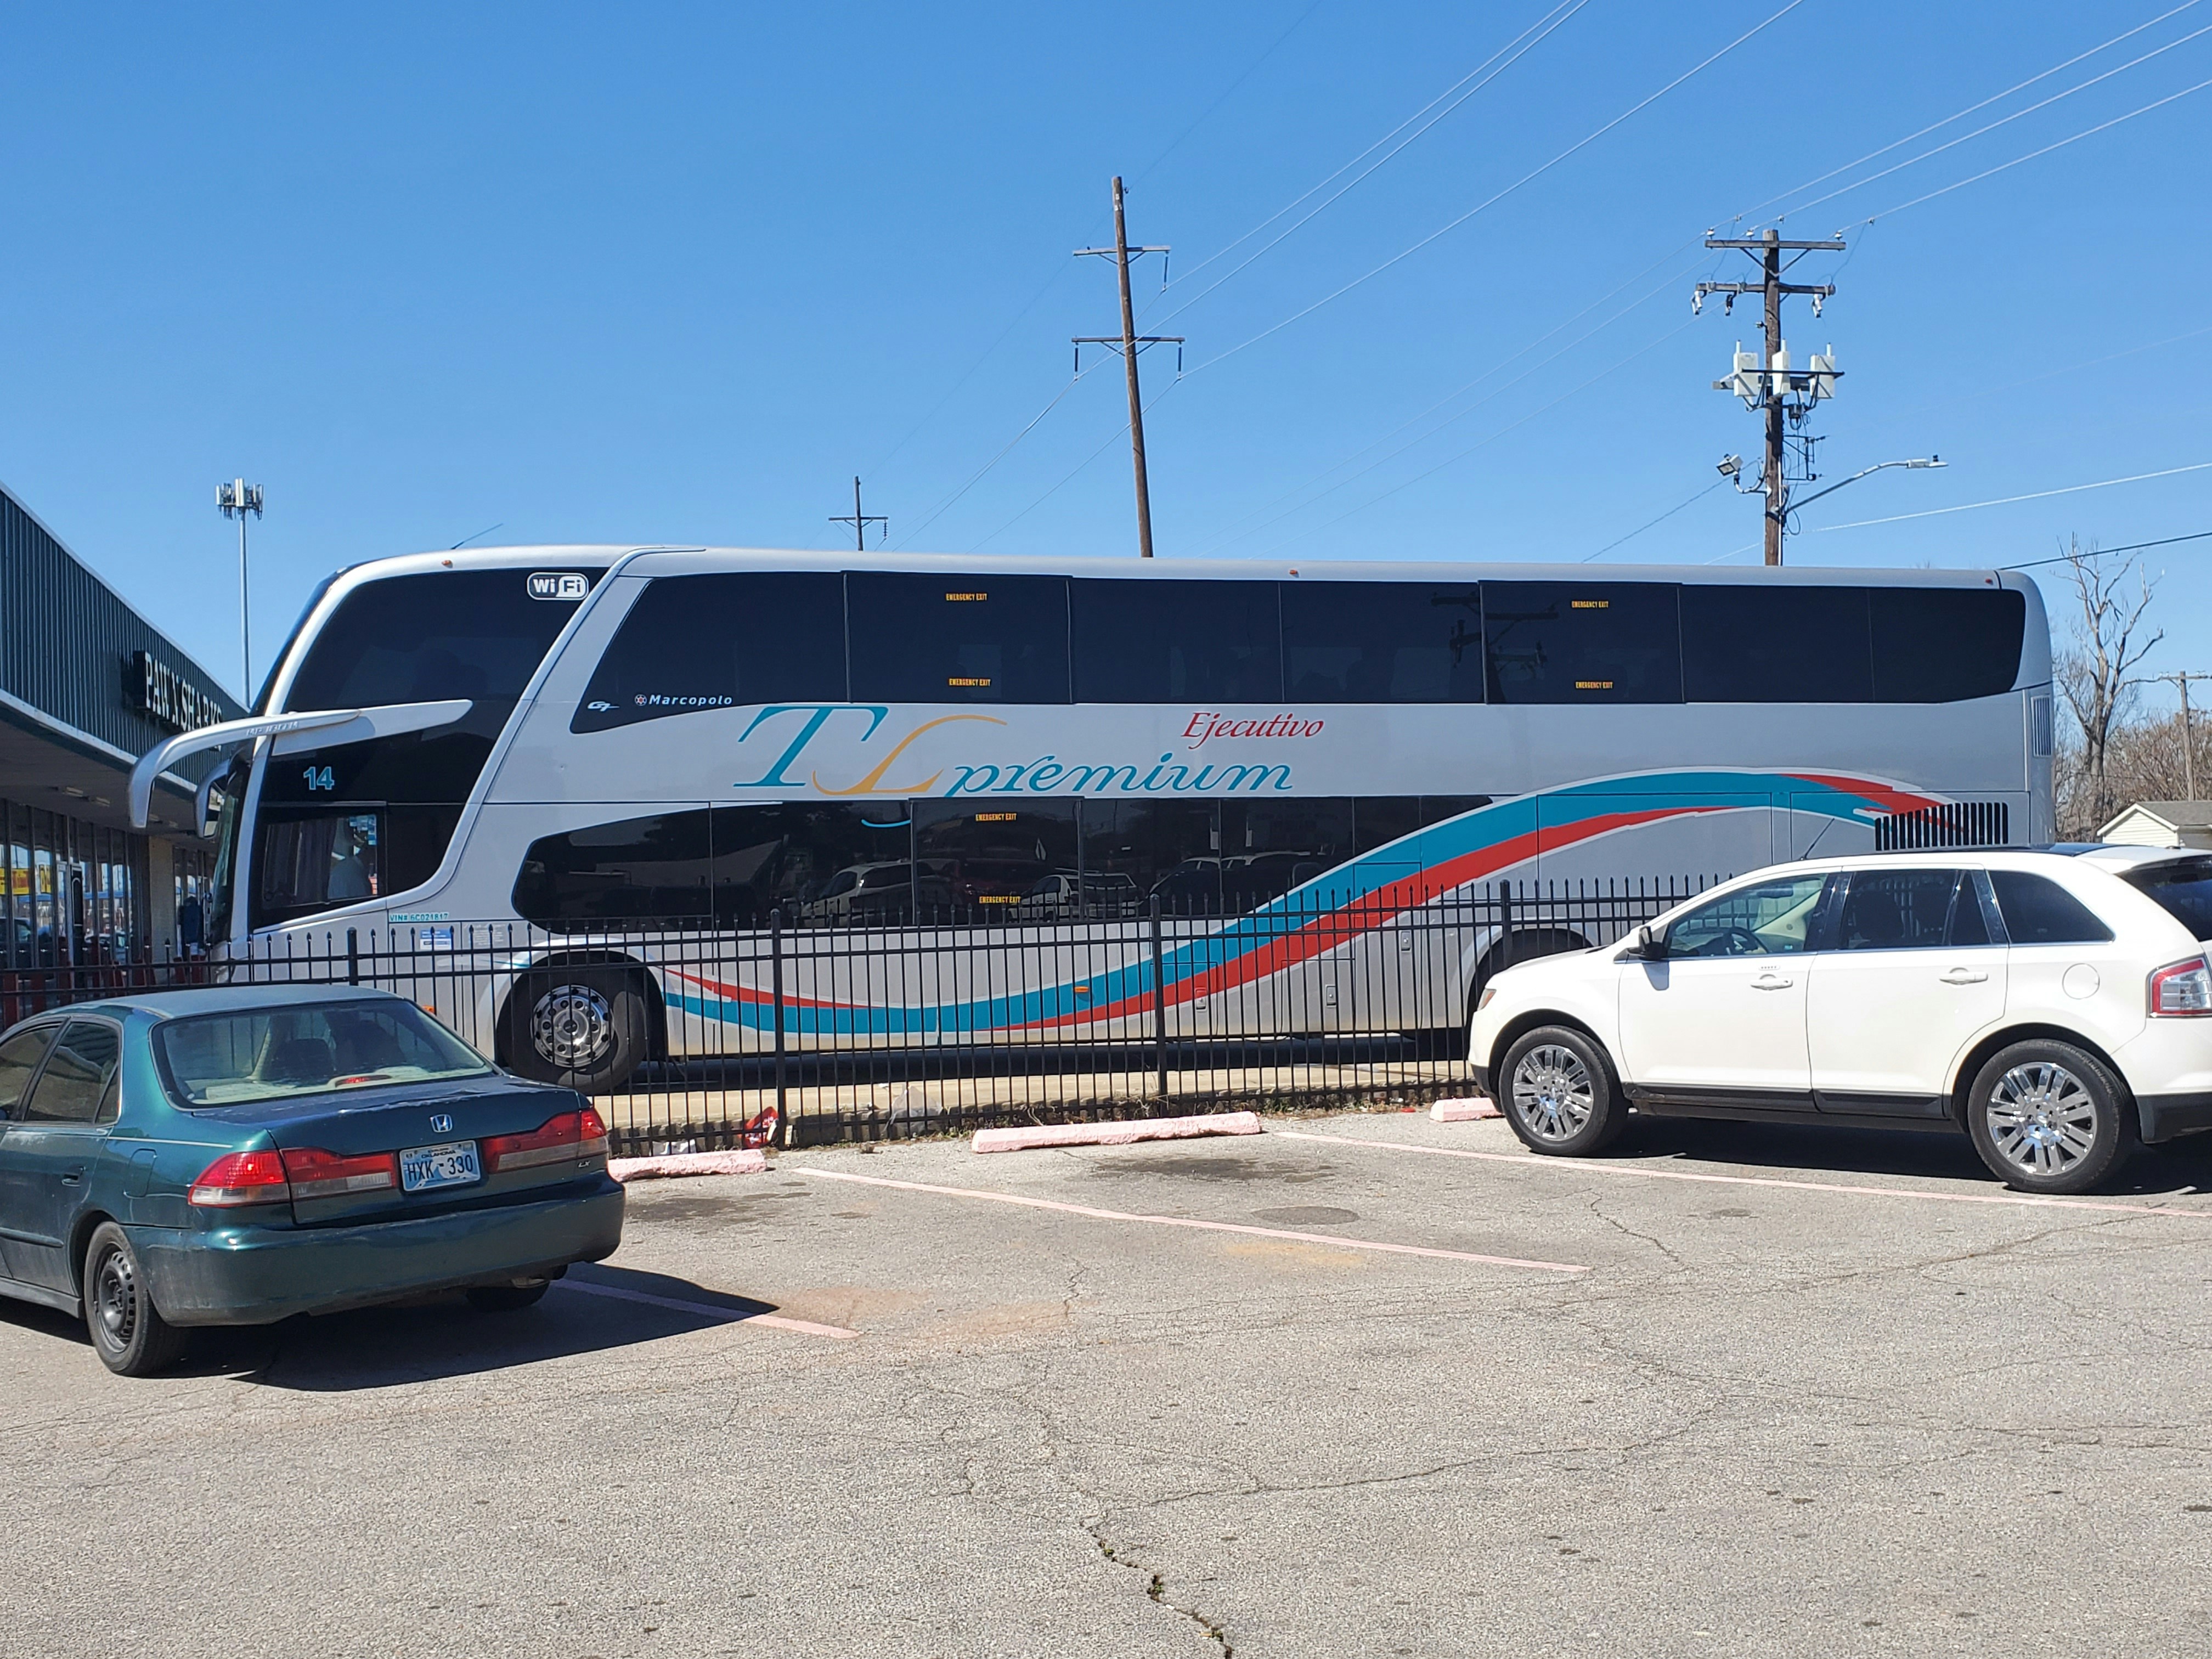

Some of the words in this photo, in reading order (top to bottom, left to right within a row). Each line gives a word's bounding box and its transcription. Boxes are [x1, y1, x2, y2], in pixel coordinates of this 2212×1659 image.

[949, 678, 978, 686] EMERGENCY
[648, 695, 732, 707] Marcopolo
[1181, 713, 1324, 750] Ejecutivo
[303, 766, 335, 791] 14
[945, 752, 1293, 798] premium
[979, 896, 1008, 904] EMERGENCY
